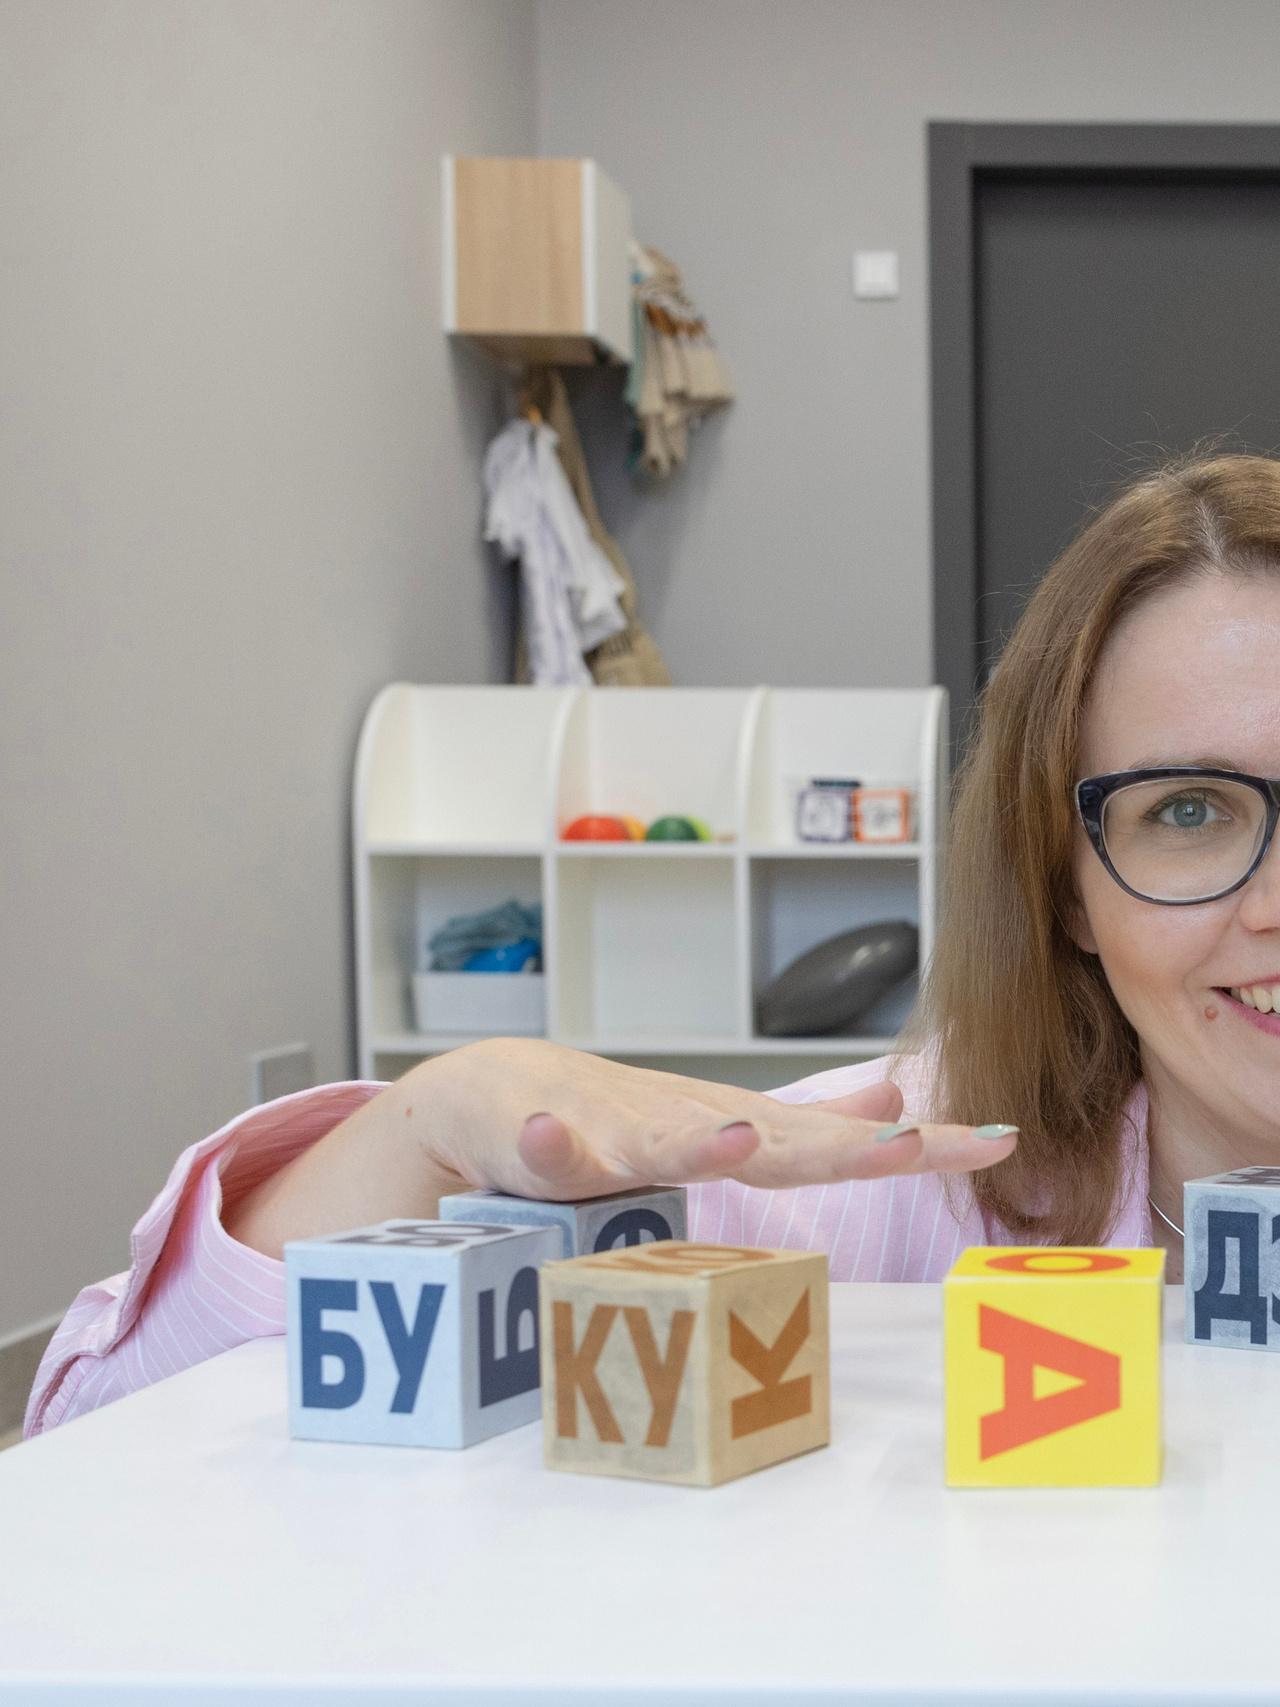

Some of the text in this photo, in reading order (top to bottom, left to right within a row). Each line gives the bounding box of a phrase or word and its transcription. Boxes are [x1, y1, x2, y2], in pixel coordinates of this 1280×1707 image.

[985, 1252, 1131, 1275] О
[299, 1278, 447, 1414] БУ
[478, 1266, 541, 1409] Б
[552, 1300, 697, 1448] КУ
[729, 1285, 812, 1441] К
[979, 1303, 1121, 1463] А
